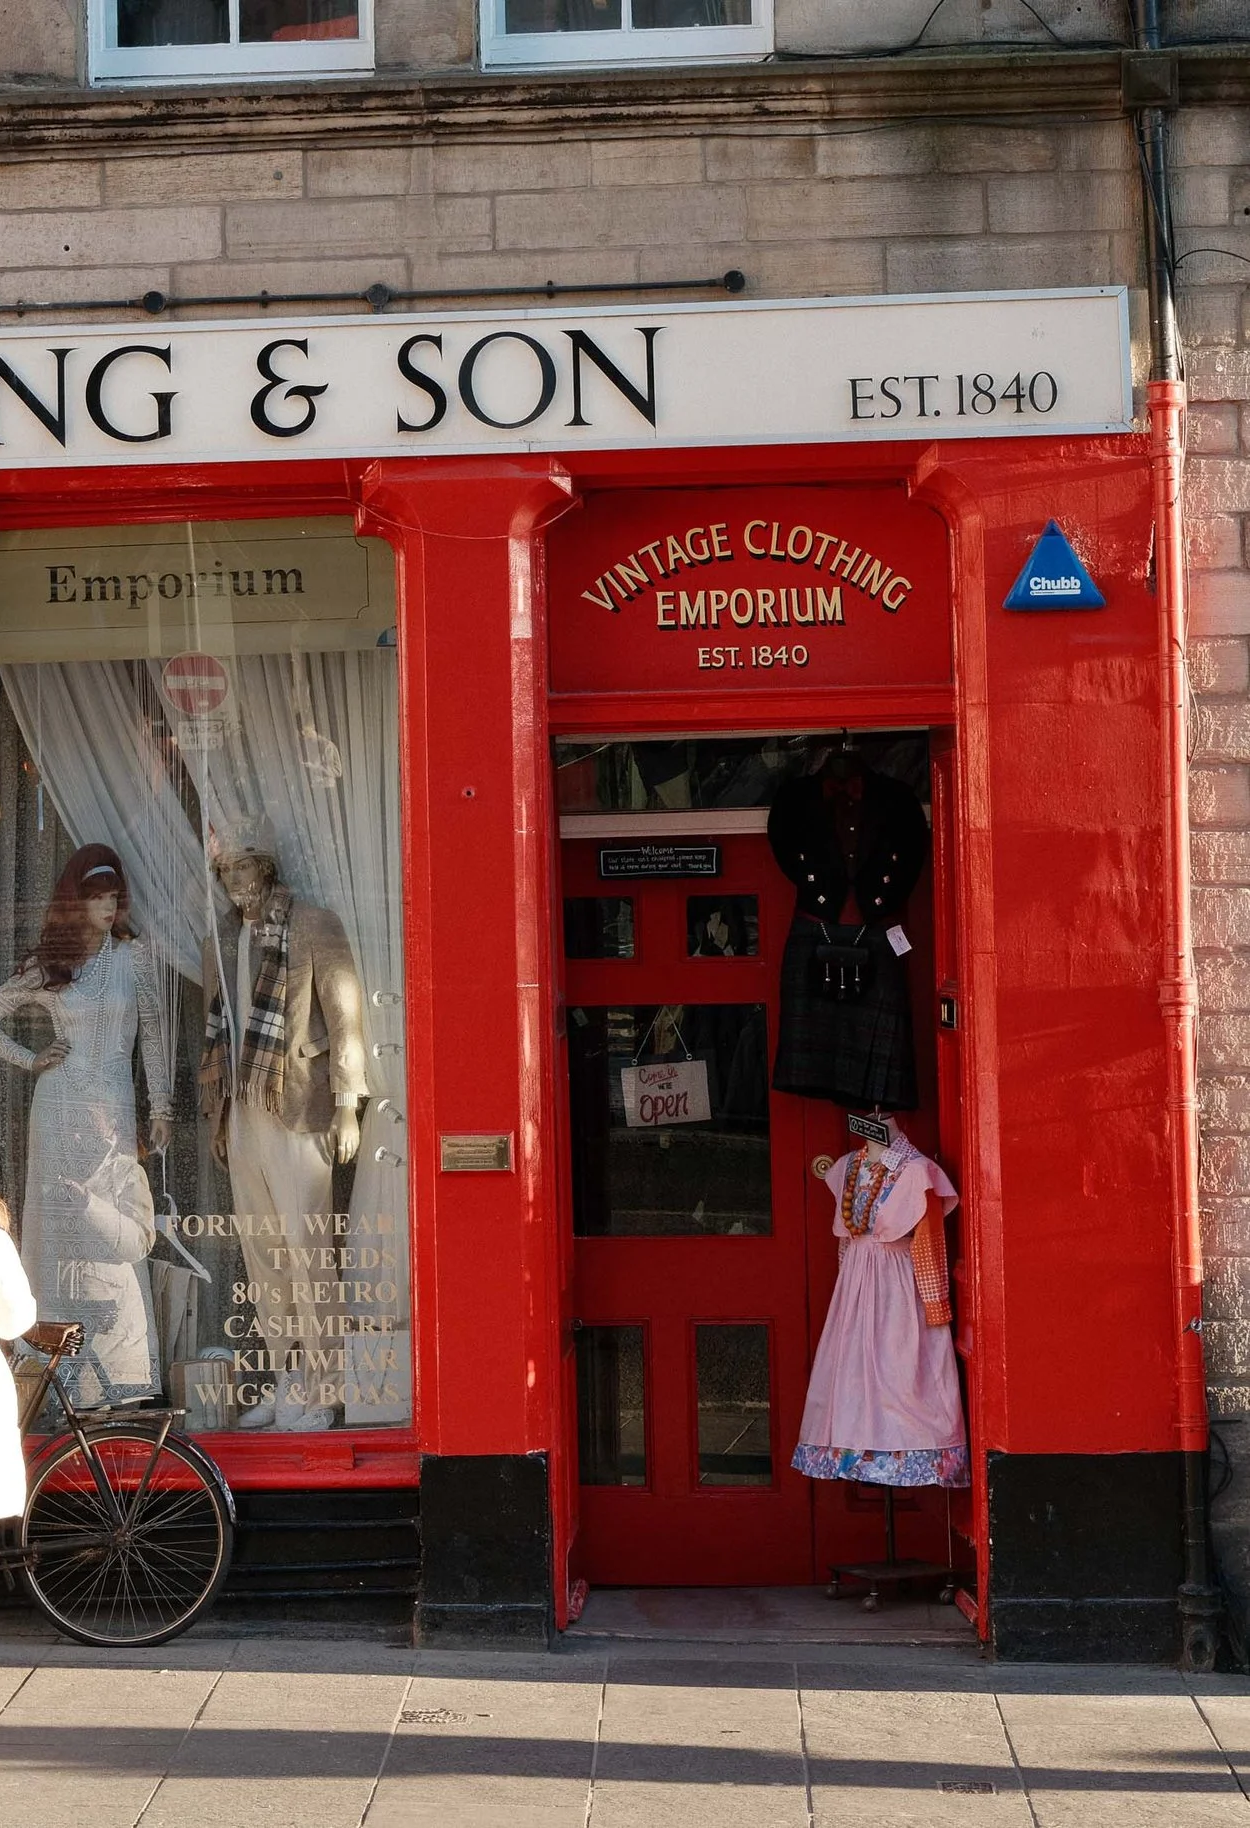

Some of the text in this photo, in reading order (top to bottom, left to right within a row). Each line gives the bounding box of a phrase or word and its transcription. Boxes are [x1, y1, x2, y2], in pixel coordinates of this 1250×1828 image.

[250, 337, 330, 438] &
[396, 326, 667, 433] SON
[954, 371, 1058, 416] 1840
[580, 519, 913, 613] VINTAGE CLOTHING
[45, 558, 306, 610] Emporium
[1030, 576, 1081, 590] Chubb
[655, 586, 846, 630] EMPORIUM
[697, 644, 810, 668] EST. 1840
[164, 1214, 295, 1237] FORMAL
[267, 1247, 398, 1270] TWEEDS
[232, 1280, 399, 1304] 80's RETRO
[223, 1315, 398, 1338] CASHMERE
[232, 1347, 399, 1372] KILTWEAR
[194, 1382, 400, 1406] WIGS & BOAS
